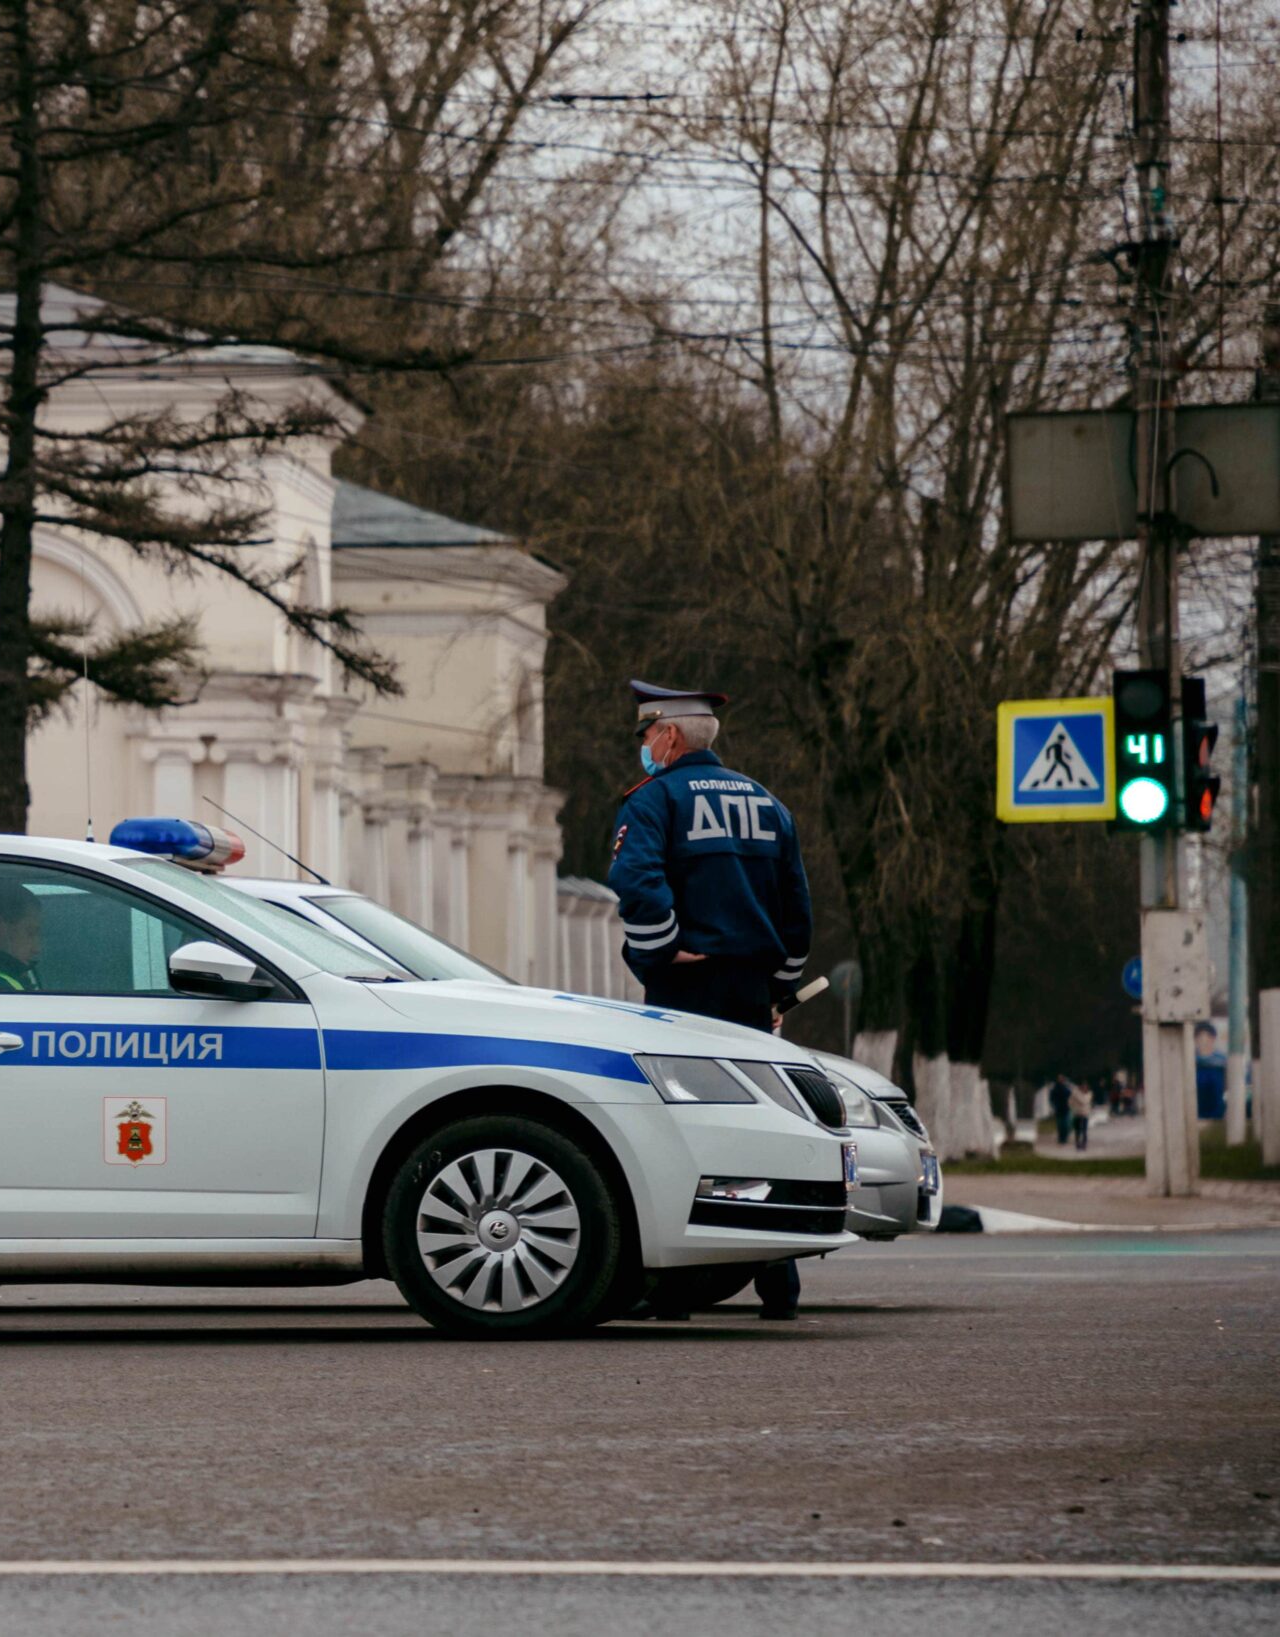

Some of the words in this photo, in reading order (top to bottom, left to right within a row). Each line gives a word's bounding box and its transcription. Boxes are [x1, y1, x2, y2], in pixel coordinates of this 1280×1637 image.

[1125, 734, 1165, 764] 41
[687, 794, 776, 841] ДПС
[32, 1031, 223, 1064] ПОЛИЦИЯ
